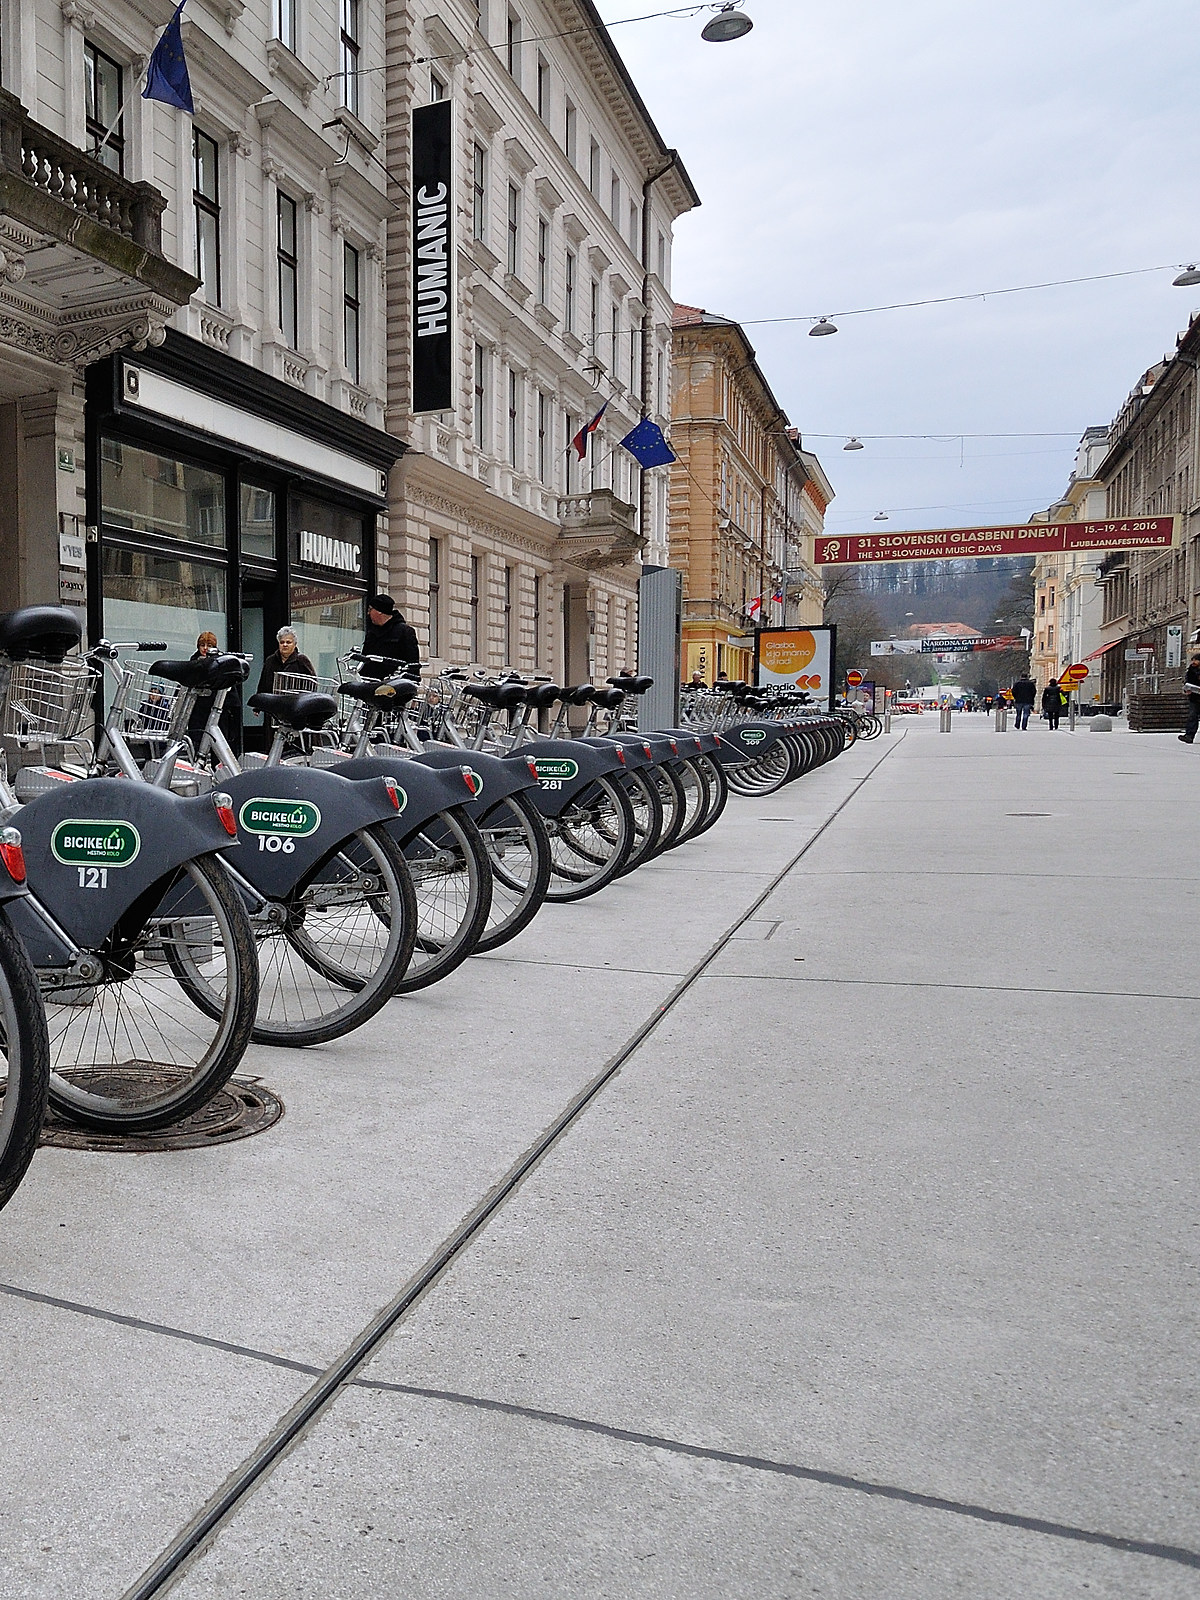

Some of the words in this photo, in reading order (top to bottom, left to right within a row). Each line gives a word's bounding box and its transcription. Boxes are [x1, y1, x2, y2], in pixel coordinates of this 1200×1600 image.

[417, 181, 448, 337] HUMANIC
[1120, 523, 1131, 532] 4.
[1132, 521, 1157, 531] 2016
[857, 538, 876, 549] 31.
[878, 534, 947, 548] SLOVENSKI
[950, 529, 1014, 543] GLASBENI
[1017, 528, 1059, 540] DNEVI
[1070, 536, 1166, 548] LJUBLJANAFESTIVAL.SI
[300, 531, 361, 573] HUMANIC
[857, 551, 873, 560] THE
[891, 548, 943, 557] SLOVENIAN
[945, 545, 975, 555] MUSIC
[978, 544, 1002, 552] DAYS
[961, 638, 996, 646] GALERIJA
[766, 683, 796, 691] Radio
[541, 780, 562, 790] 281
[251, 810, 307, 824] BICIKE(LJ)
[63, 836, 125, 850] BICIKE(LJ)
[258, 835, 295, 854] 106
[77, 867, 108, 889] 121
